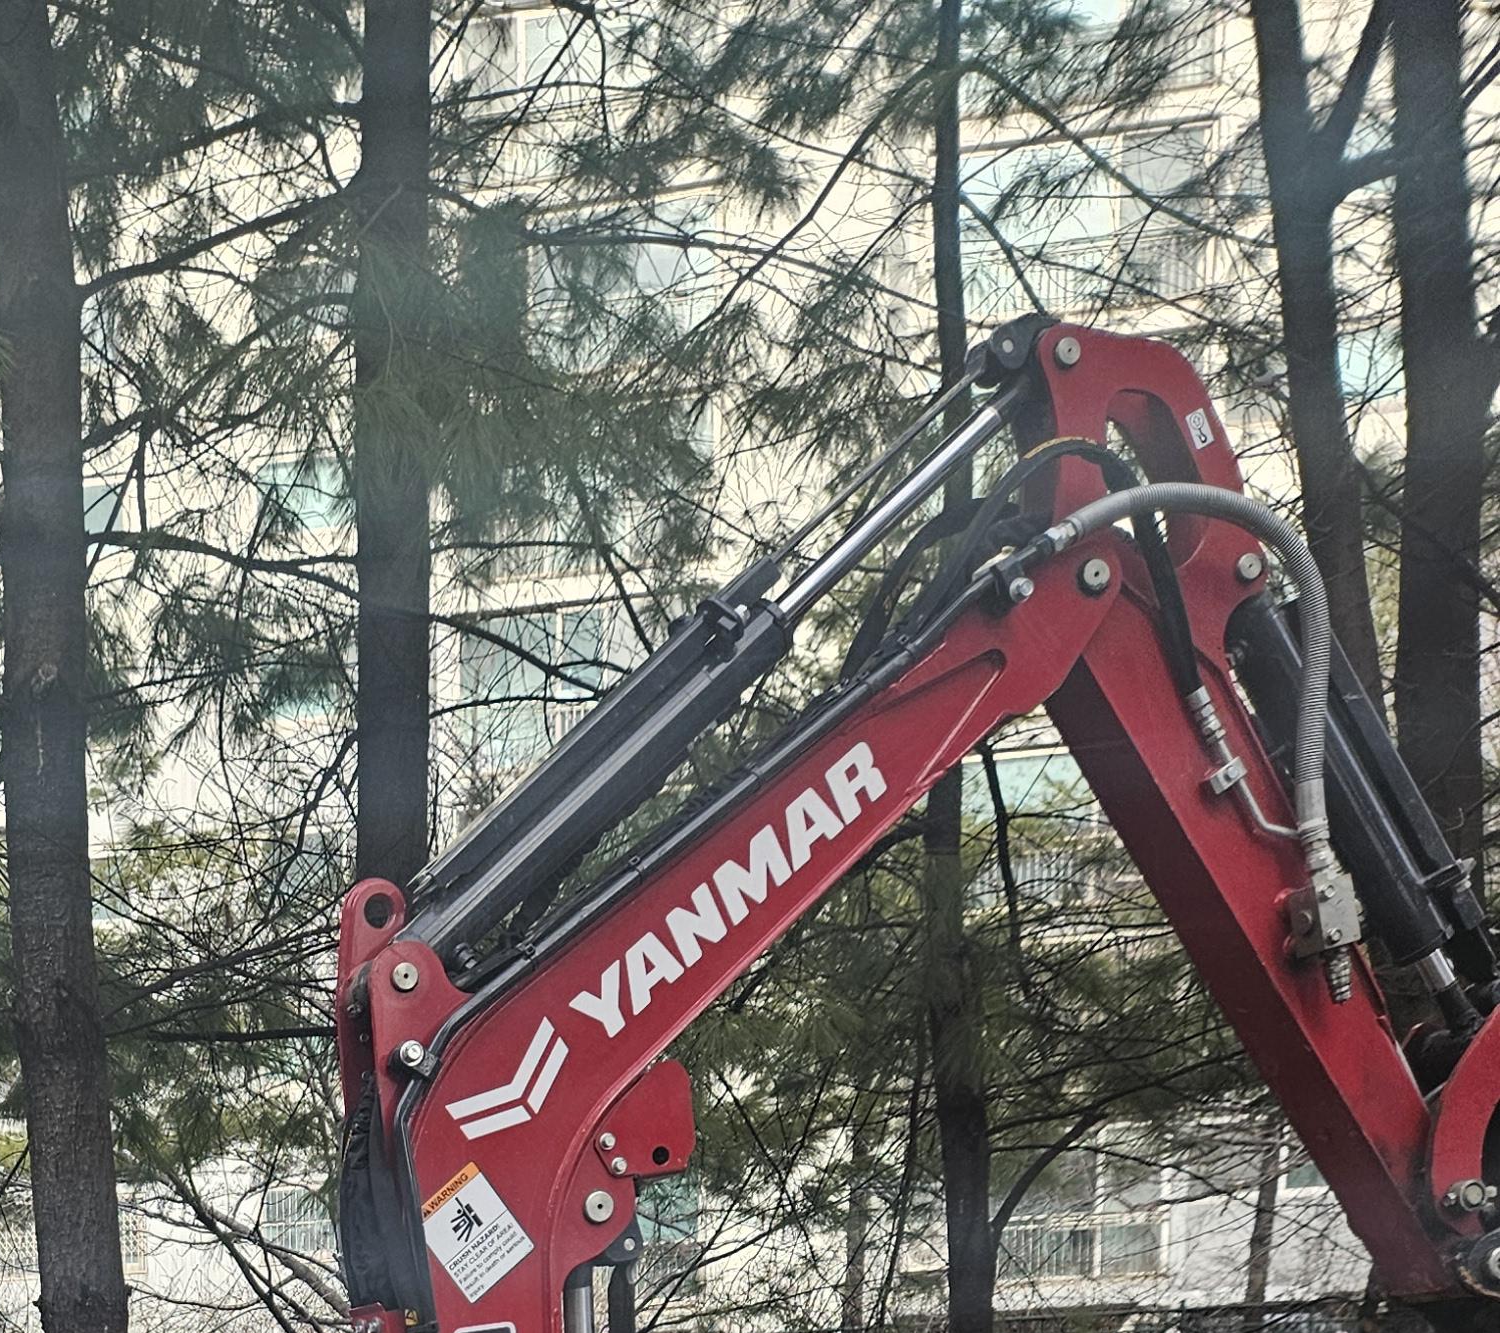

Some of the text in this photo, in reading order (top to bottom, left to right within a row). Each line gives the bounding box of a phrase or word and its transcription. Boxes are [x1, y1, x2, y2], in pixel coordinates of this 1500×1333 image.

[569, 741, 888, 1039] YANMAR
[427, 1172, 469, 1210] WARNING
[448, 1248, 471, 1270] CRUSH
[453, 1263, 468, 1277] STAY
[468, 1245, 487, 1263] CLEAR
[487, 1238, 495, 1246] OF
